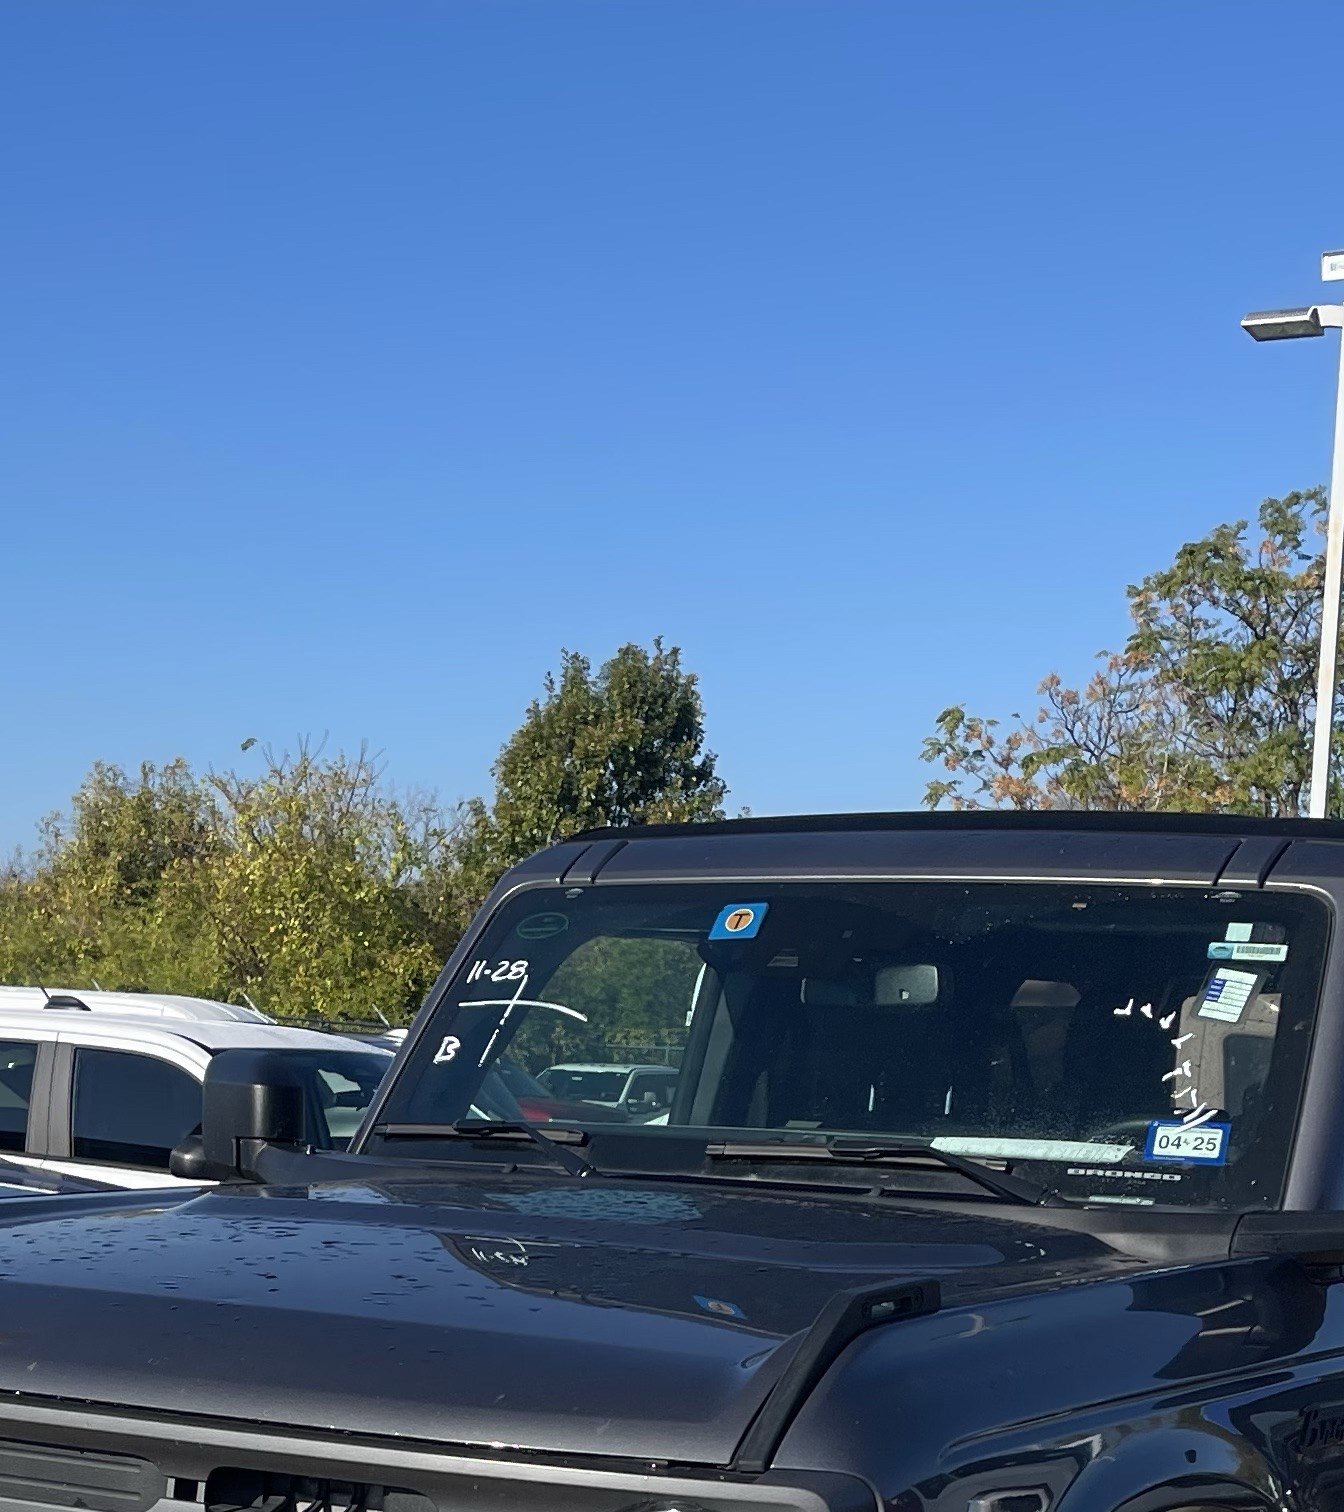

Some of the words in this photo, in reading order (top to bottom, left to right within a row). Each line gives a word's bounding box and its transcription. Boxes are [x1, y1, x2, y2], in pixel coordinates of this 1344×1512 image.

[733, 913, 751, 929] T
[467, 960, 528, 984] 11-28
[433, 1035, 460, 1064] B
